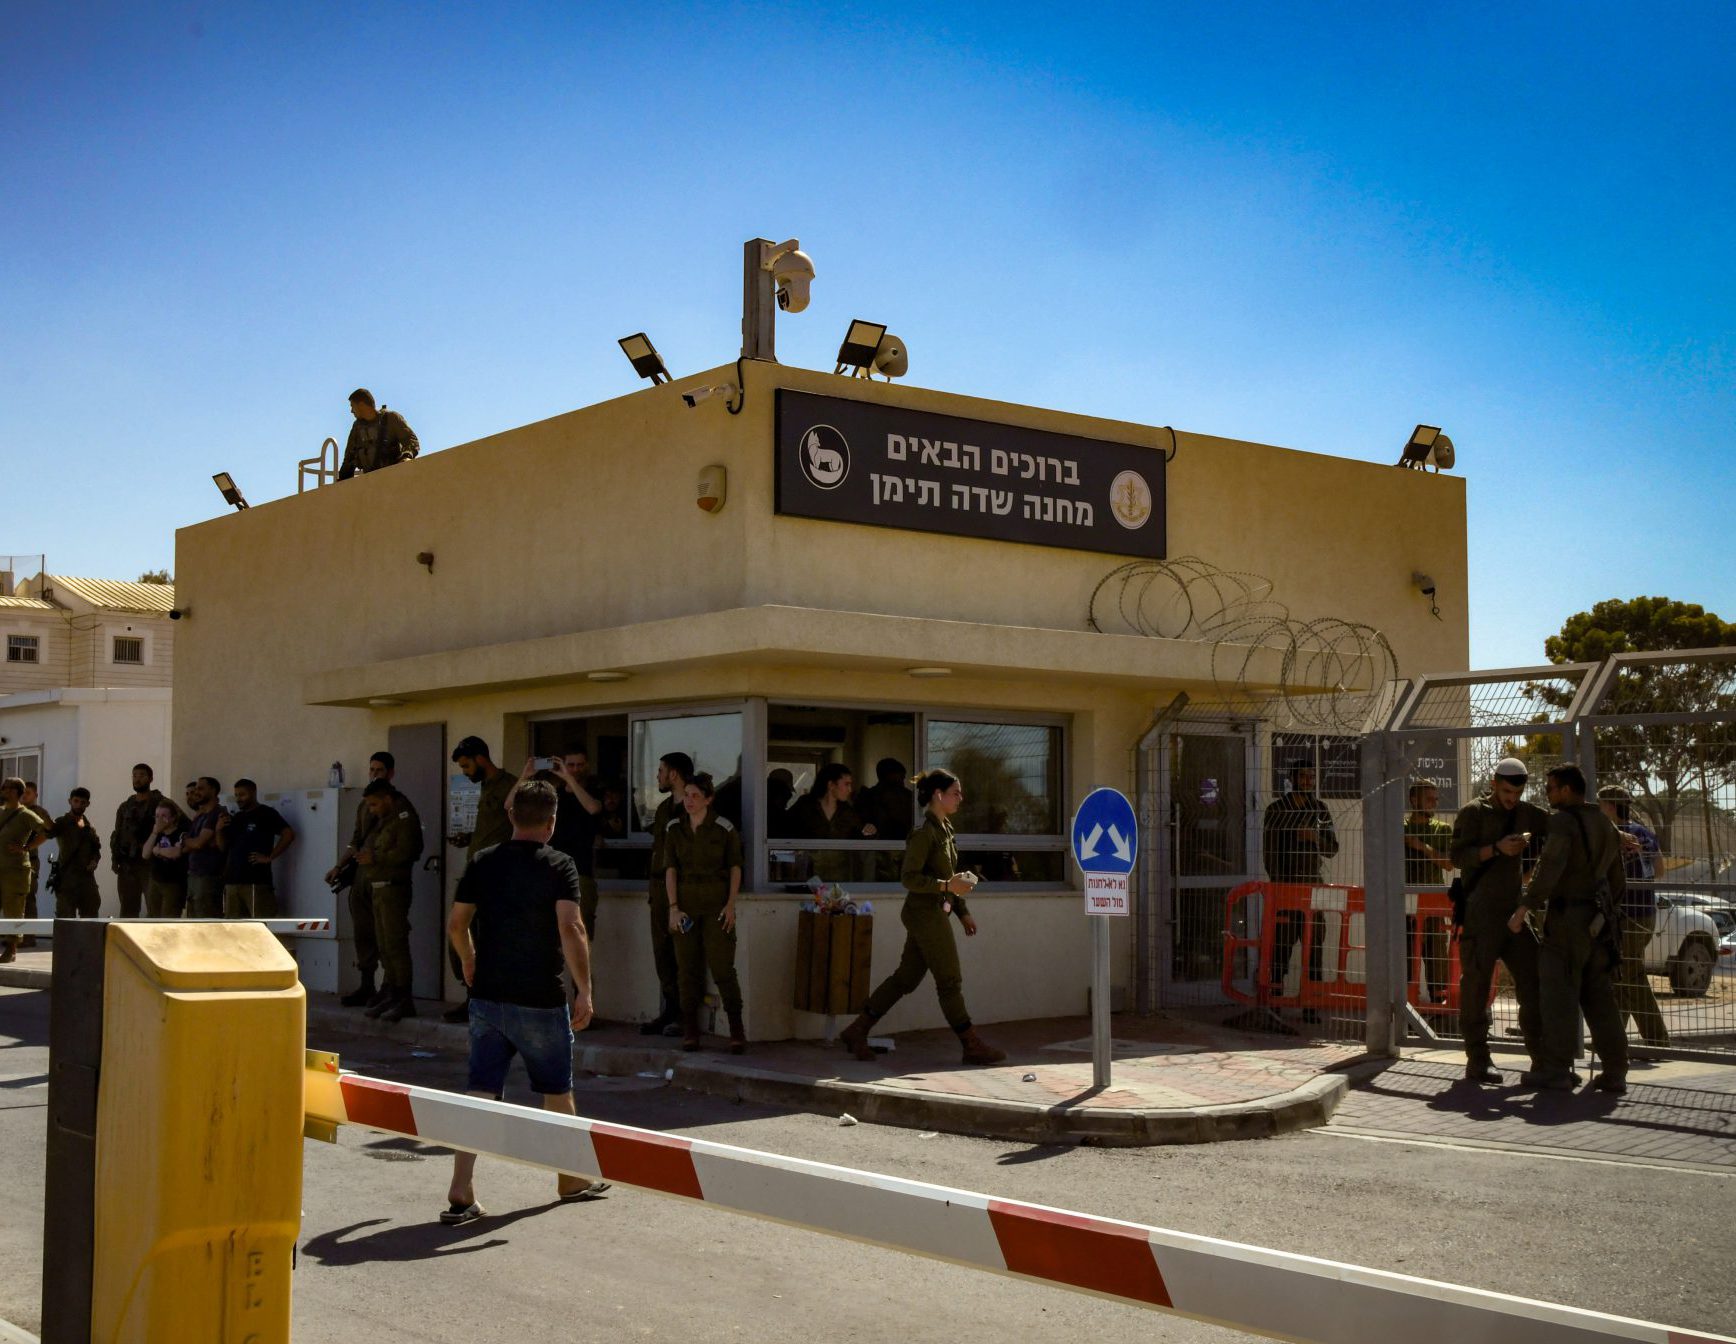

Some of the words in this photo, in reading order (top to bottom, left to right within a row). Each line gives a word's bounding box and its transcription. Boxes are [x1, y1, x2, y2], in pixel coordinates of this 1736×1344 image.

[887, 433, 981, 471] הבאים
[991, 448, 1080, 486] ברוכים
[870, 473, 941, 508] תימן
[951, 483, 1013, 516] שדה
[1023, 493, 1094, 527] מחנה
